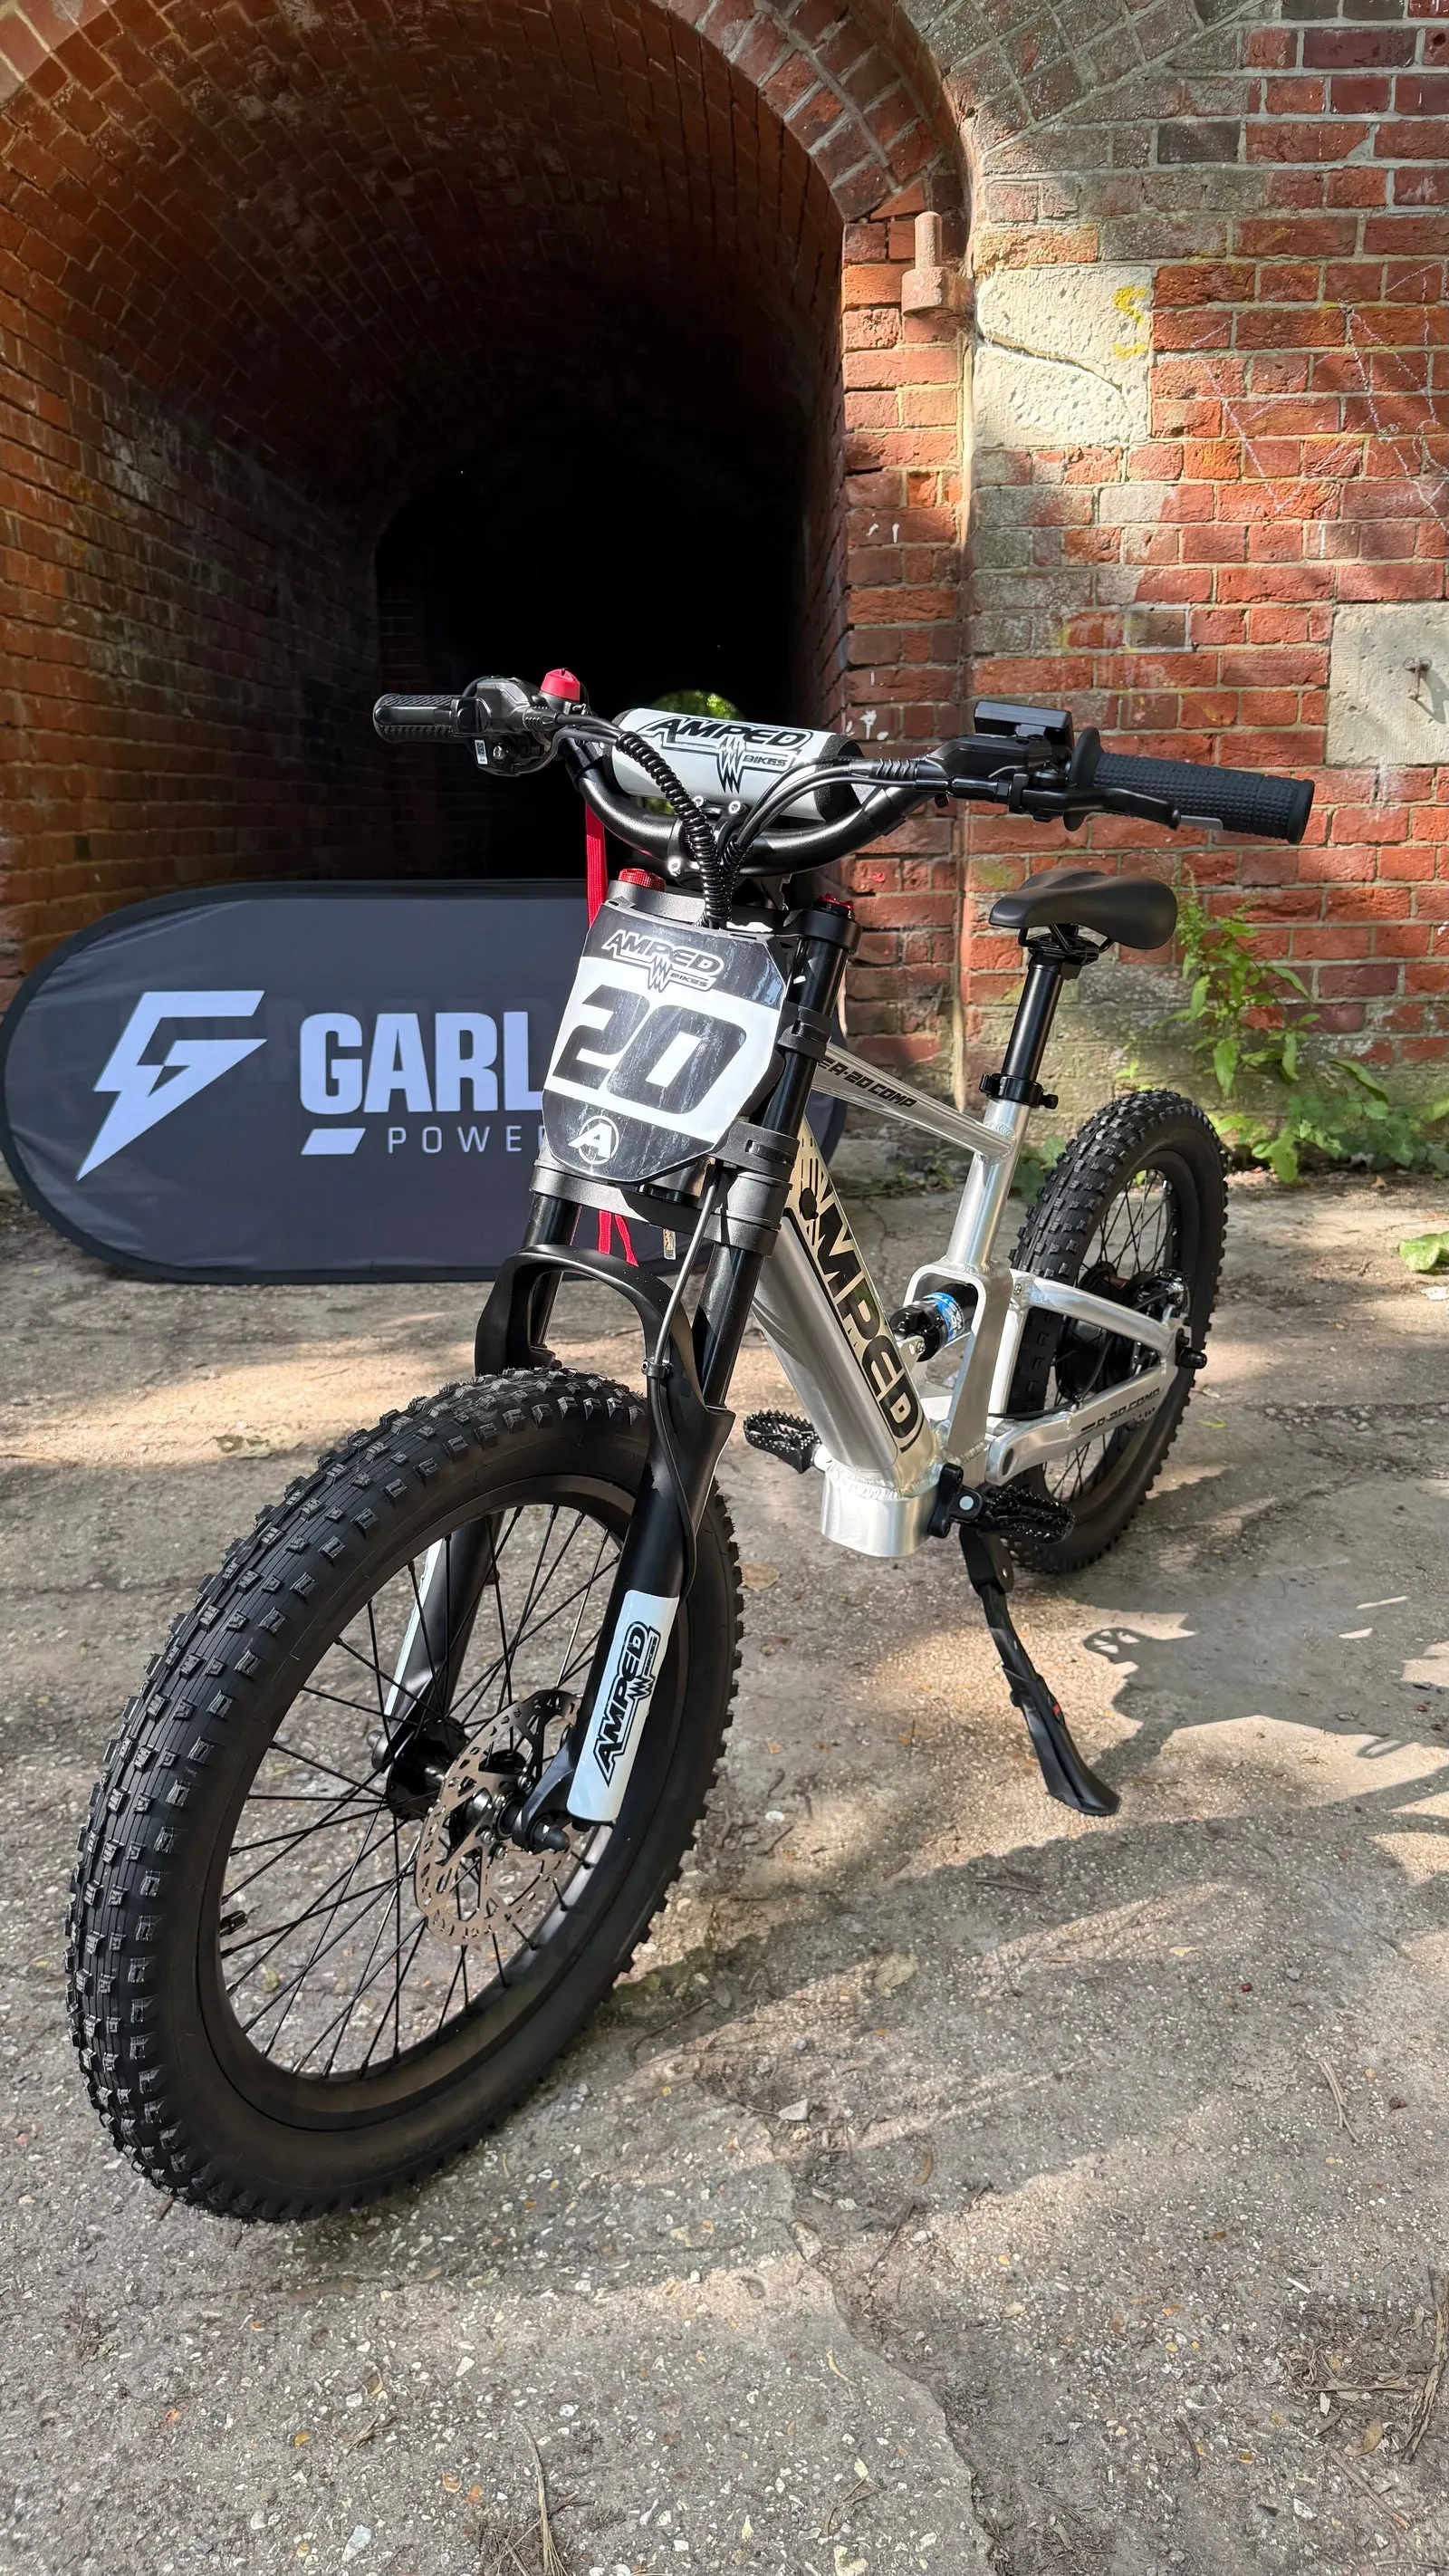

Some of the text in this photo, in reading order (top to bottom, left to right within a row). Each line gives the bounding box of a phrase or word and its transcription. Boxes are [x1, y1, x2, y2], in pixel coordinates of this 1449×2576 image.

[639, 716, 810, 748] AMPED
[743, 754, 788, 767] BIKES
[602, 930, 723, 974] AMPED
[669, 972, 709, 988] BIKES
[552, 985, 747, 1114] 20
[868, 1082, 918, 1108] COMP
[802, 1179, 920, 1439] MPED
[597, 1625, 646, 1773] AMPED
